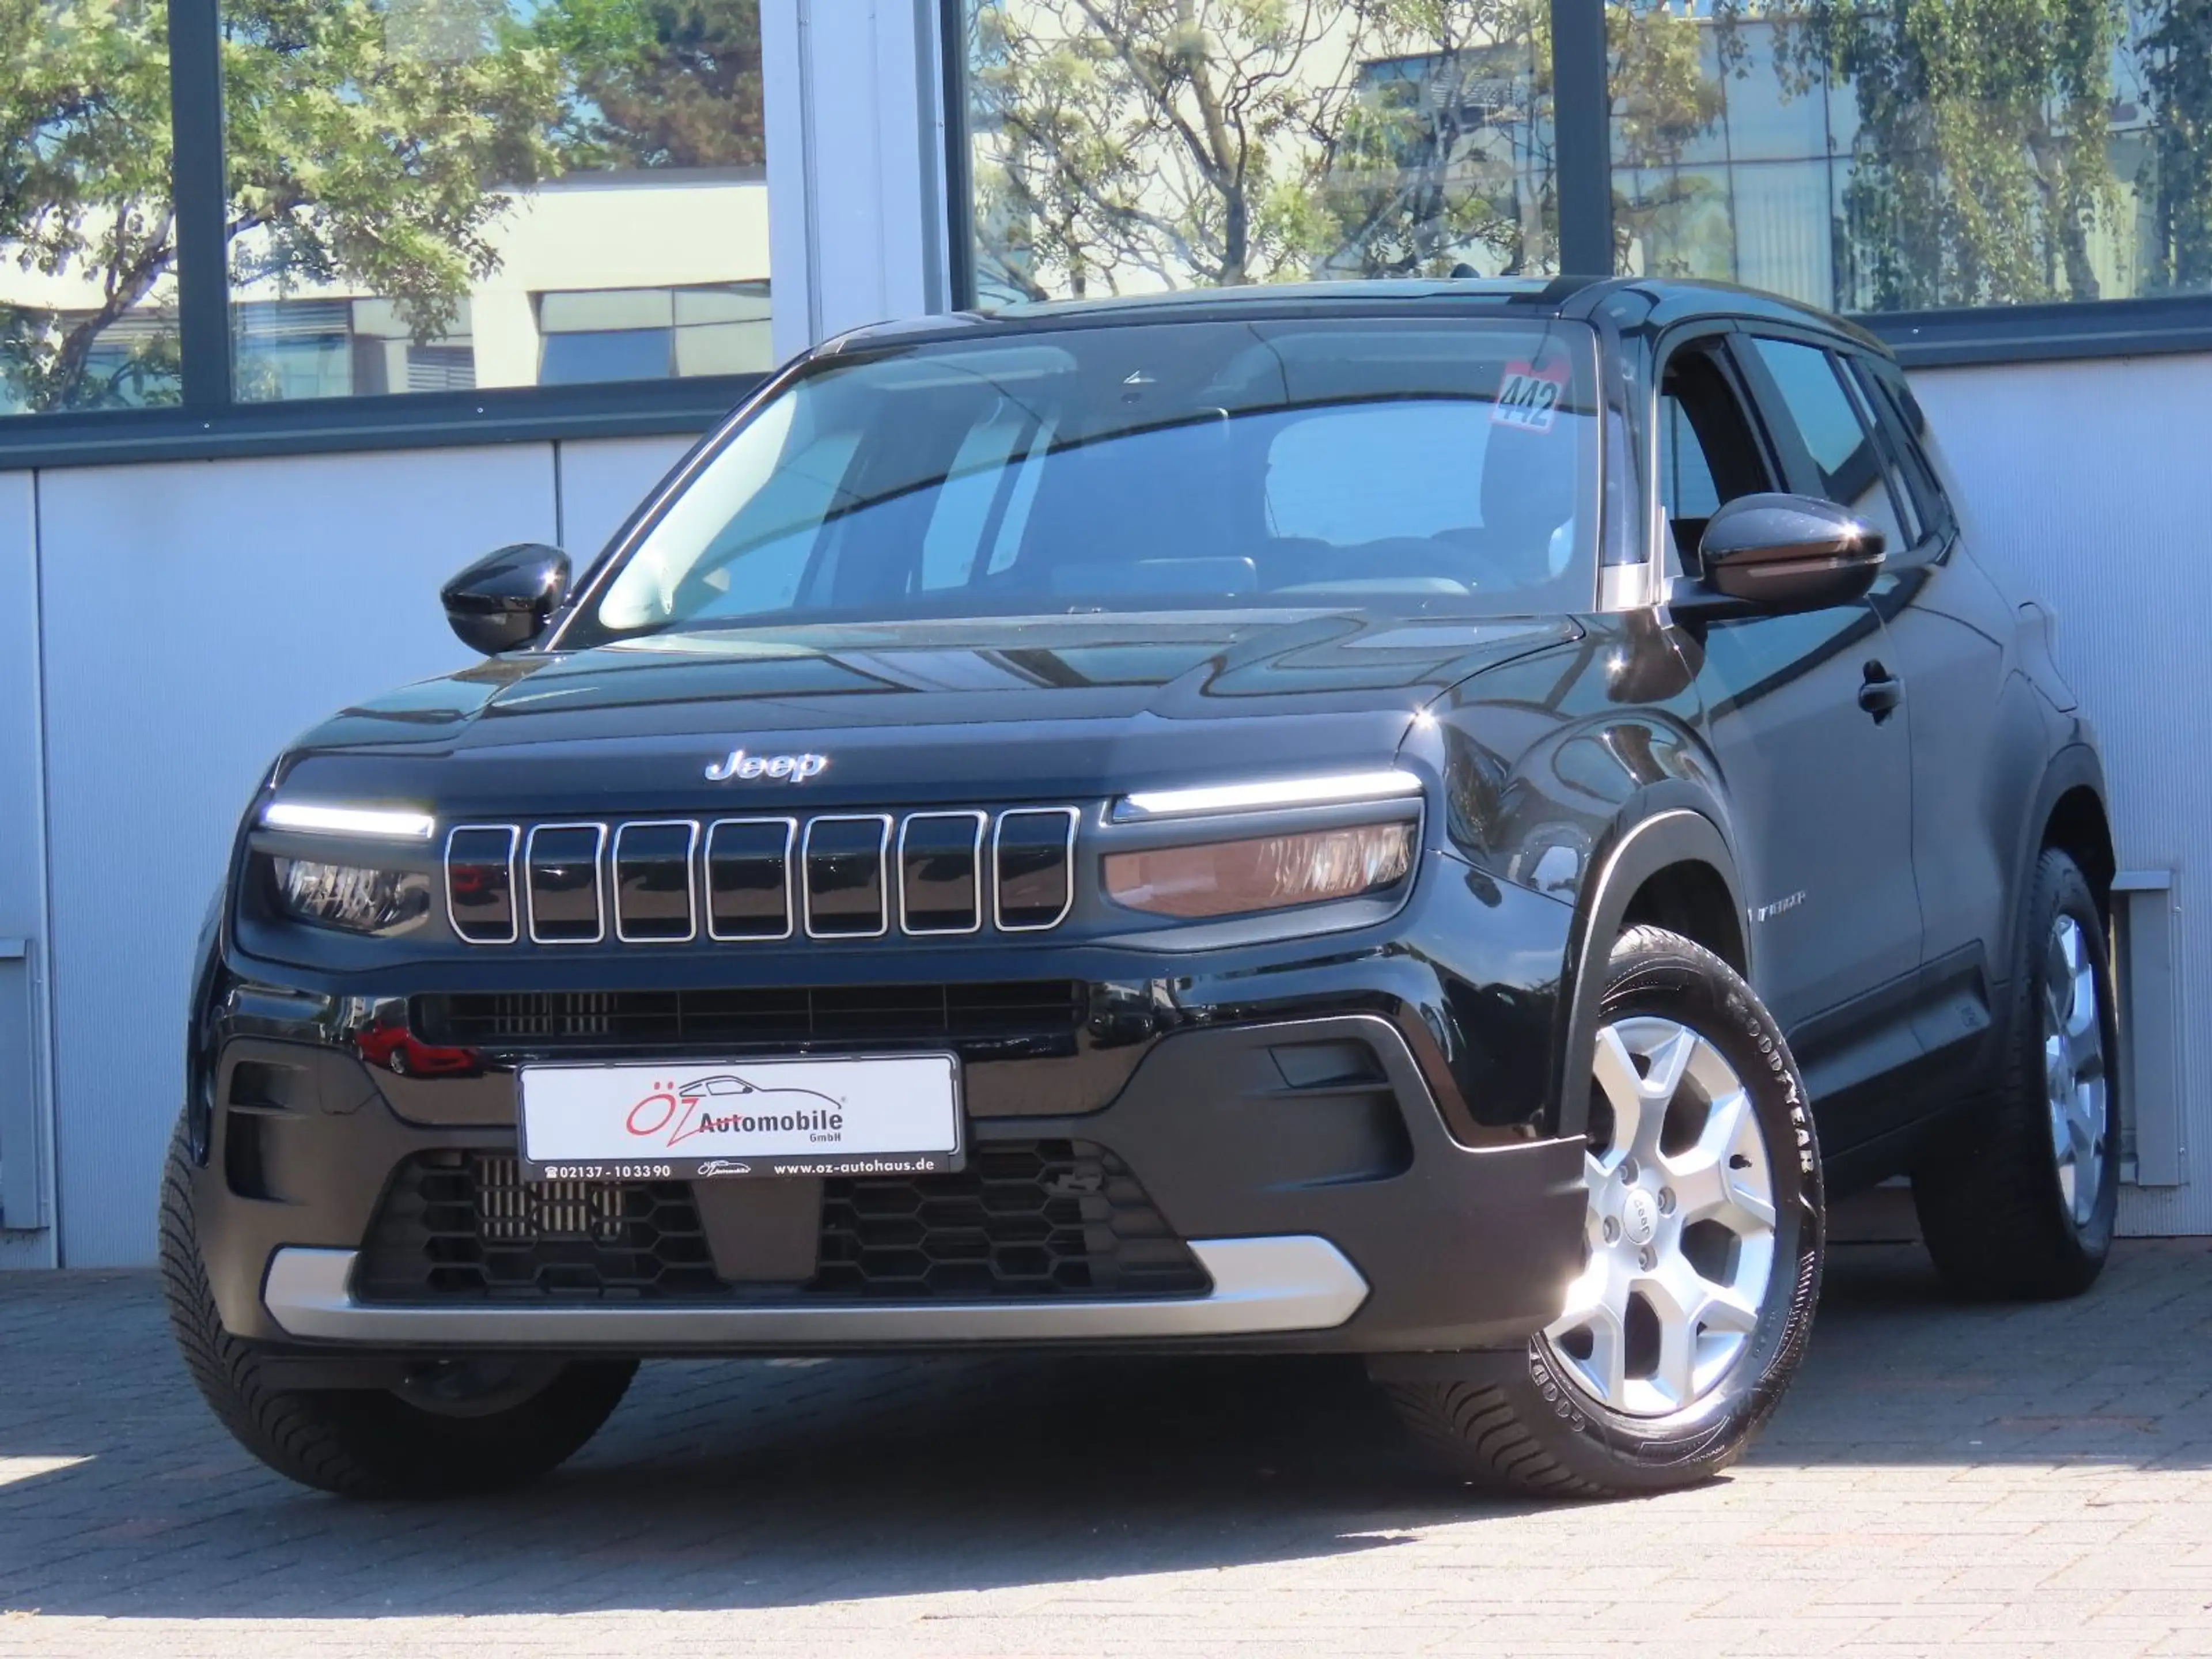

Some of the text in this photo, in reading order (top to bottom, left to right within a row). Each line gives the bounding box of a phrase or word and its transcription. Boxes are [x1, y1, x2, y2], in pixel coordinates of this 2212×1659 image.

[1498, 376, 1558, 426] 442
[705, 750, 827, 783] Jeep
[699, 1110, 843, 1132] Automobile
[809, 1133, 841, 1142] GmbH
[774, 1157, 934, 1174] www.oz-autohaus.de
